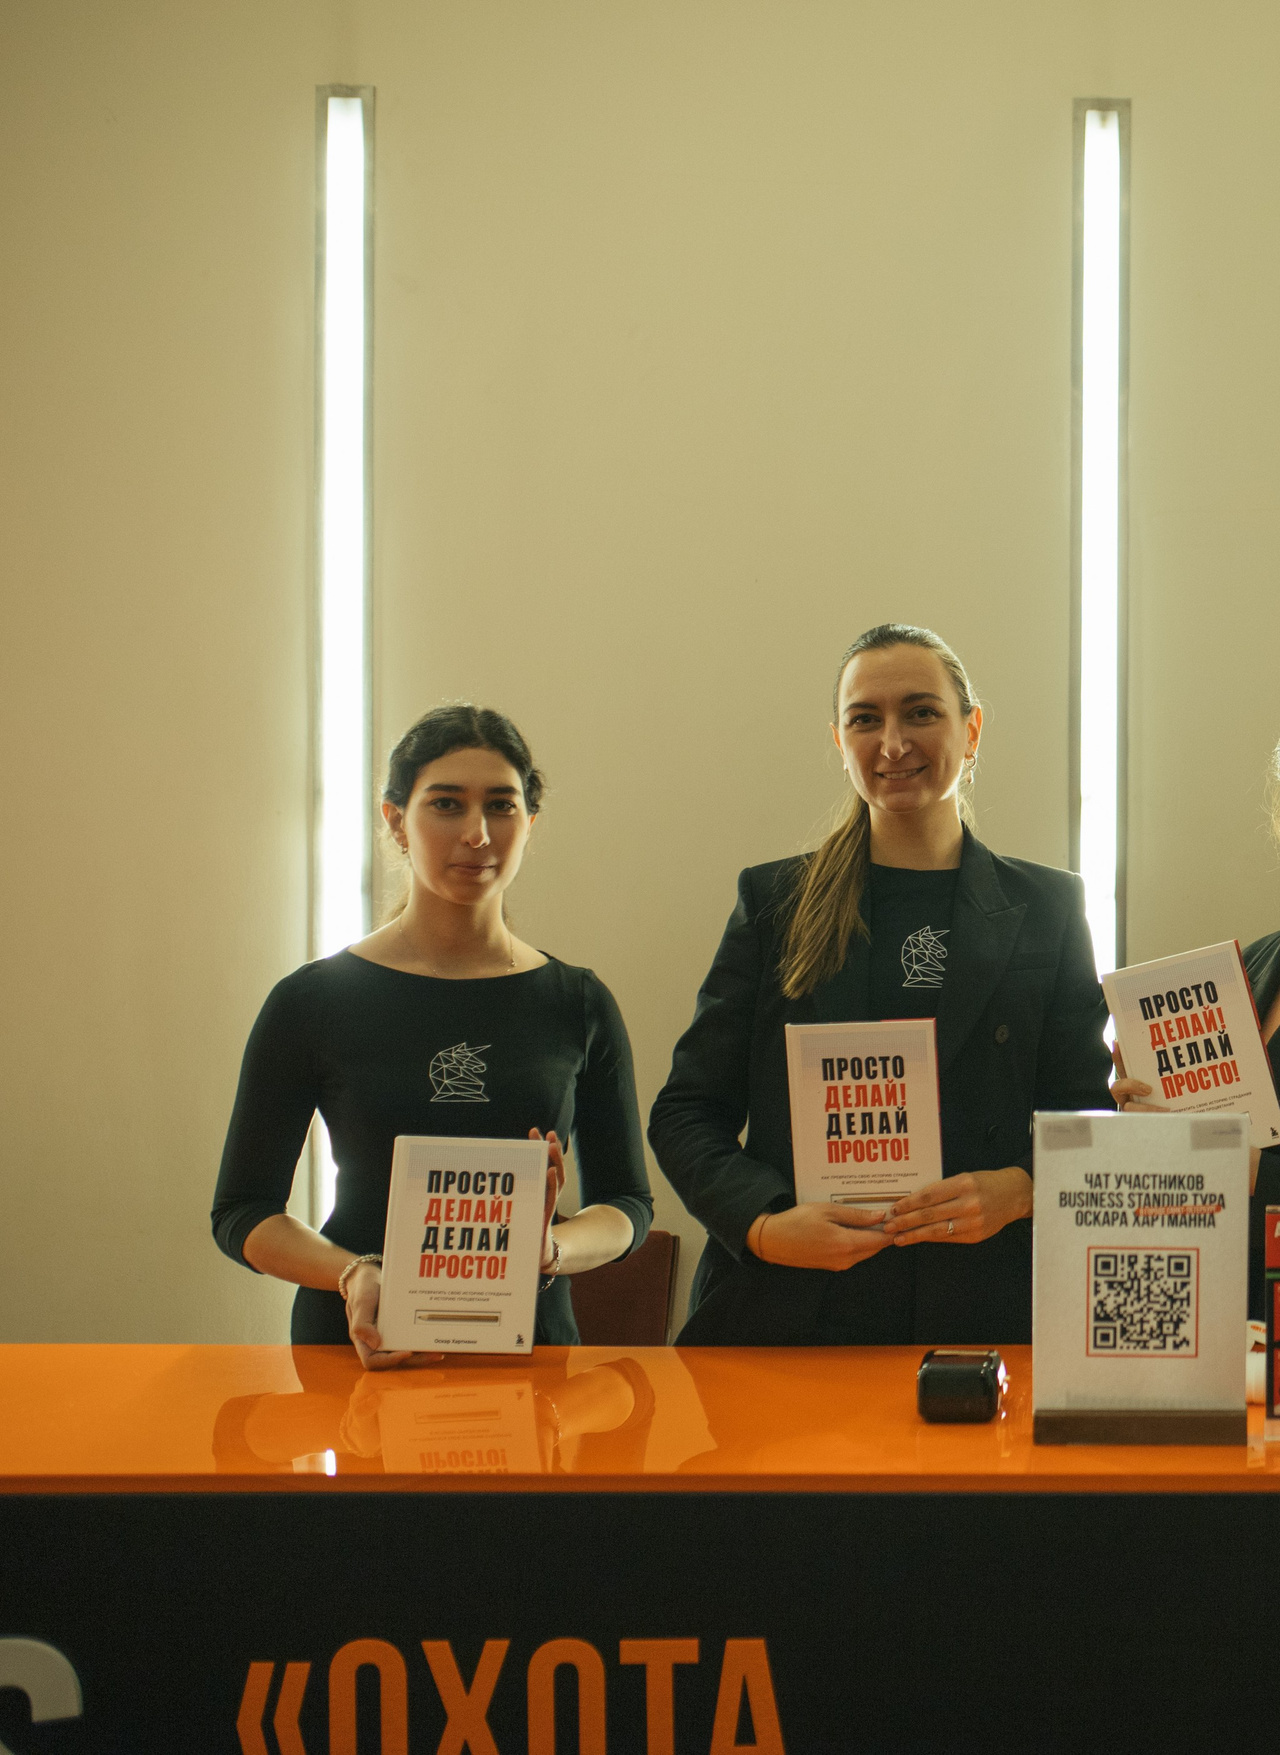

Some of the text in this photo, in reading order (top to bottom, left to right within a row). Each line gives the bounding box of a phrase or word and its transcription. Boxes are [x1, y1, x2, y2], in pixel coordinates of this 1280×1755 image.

[1139, 980, 1219, 1021] ПРОСТО
[1149, 1005, 1227, 1050] ДЕЛАЙ!
[821, 1055, 905, 1081] ПРОСТО
[1155, 1030, 1234, 1077] ДЕЛАЙ
[1160, 1059, 1241, 1100] ПРОСТО!
[825, 1078, 907, 1113] ДЕЛАЙ!
[826, 1106, 908, 1140] ДЕЛАЙ
[826, 1138, 910, 1164] ПРОСТО!
[427, 1170, 515, 1196] ПРОСТО
[1085, 1173, 1205, 1191] ЧАТ УЧАСТНИКОВ
[424, 1196, 513, 1225] ДЕЛАЙ!
[1059, 1191, 1124, 1209] BUSINESS
[1127, 1192, 1188, 1210] STANDUP
[1075, 1210, 1129, 1228] ОСКАРА
[421, 1224, 510, 1253] ДЕЛАЙ
[419, 1254, 507, 1280] ПРОСТО!
